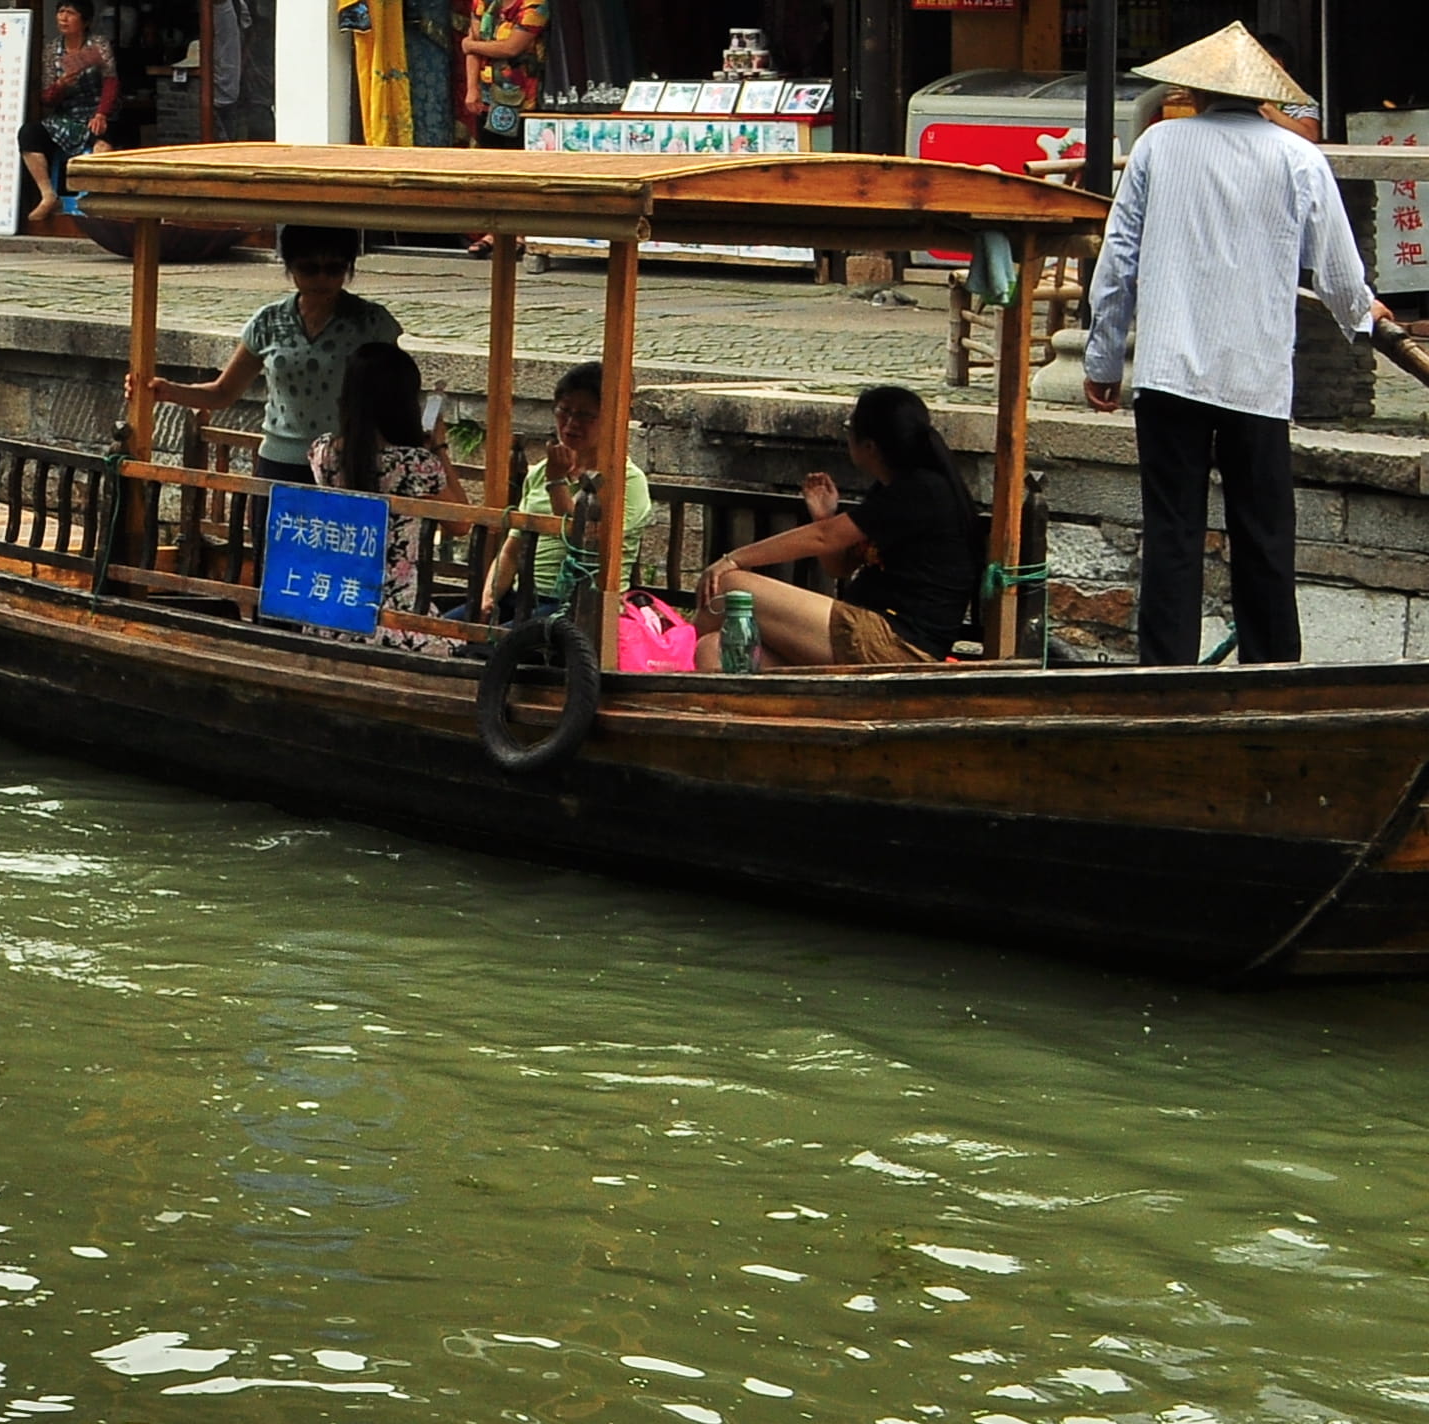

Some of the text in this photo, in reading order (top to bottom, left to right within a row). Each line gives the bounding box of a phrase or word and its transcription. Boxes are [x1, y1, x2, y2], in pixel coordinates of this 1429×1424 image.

[275, 512, 377, 557] 沪朱家角游 26
[280, 567, 361, 607] 上海港
